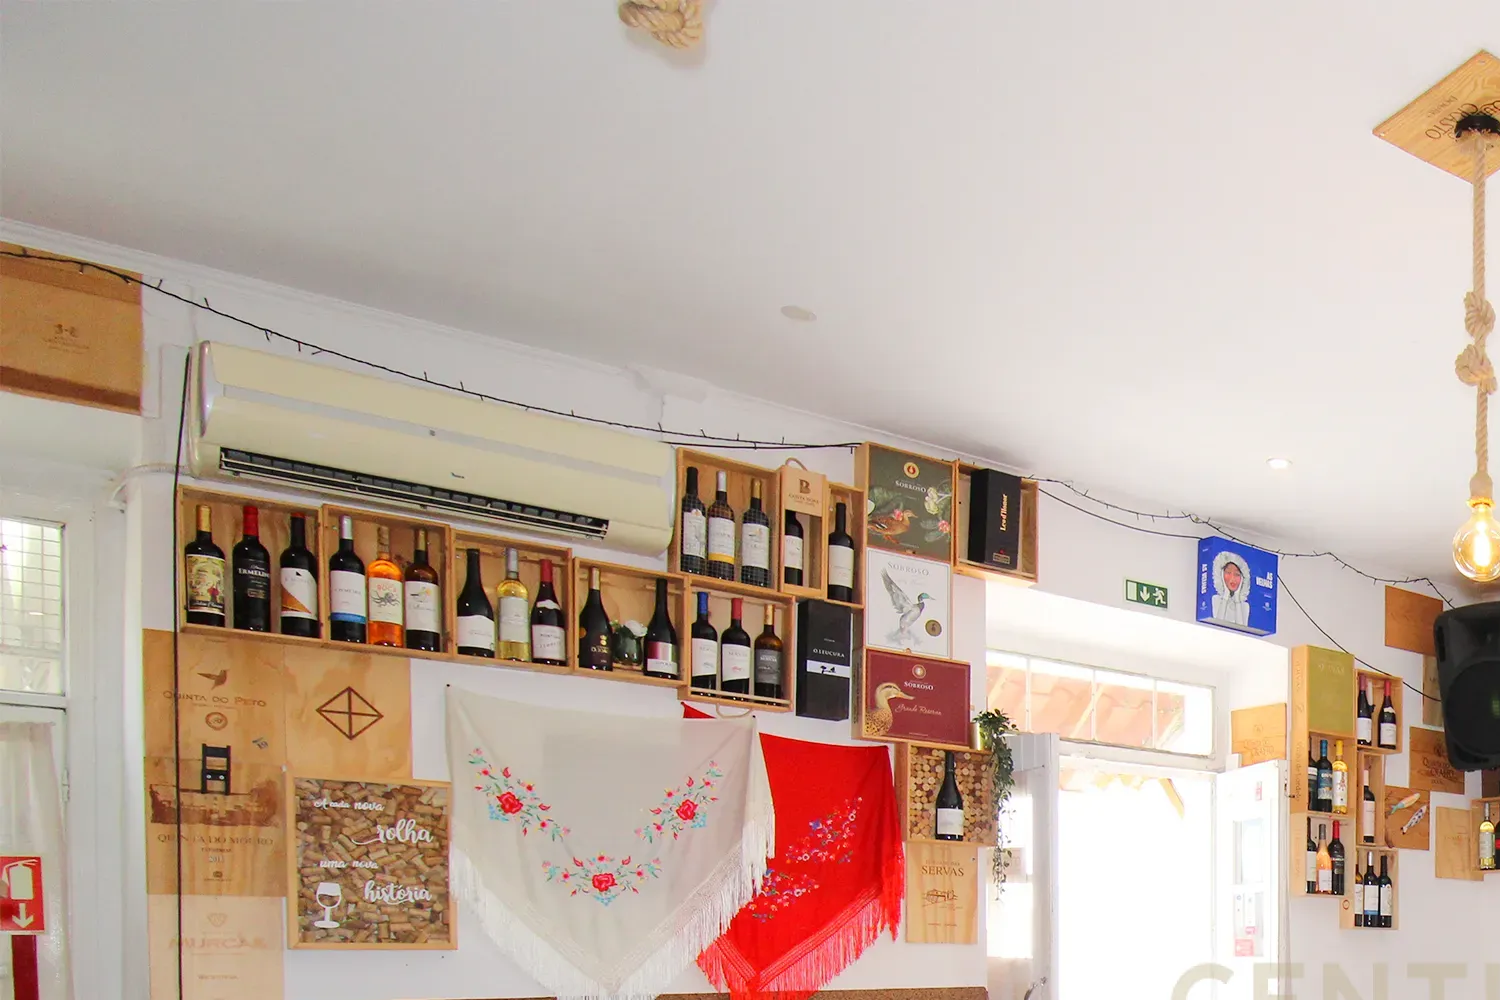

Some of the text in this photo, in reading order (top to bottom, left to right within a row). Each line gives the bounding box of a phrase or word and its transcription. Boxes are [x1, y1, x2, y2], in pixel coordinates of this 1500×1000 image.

[353, 801, 385, 812] nova
[351, 818, 434, 846] rolha
[319, 859, 379, 869] uma nova
[921, 865, 964, 877] SERVAS
[364, 879, 433, 905] história
